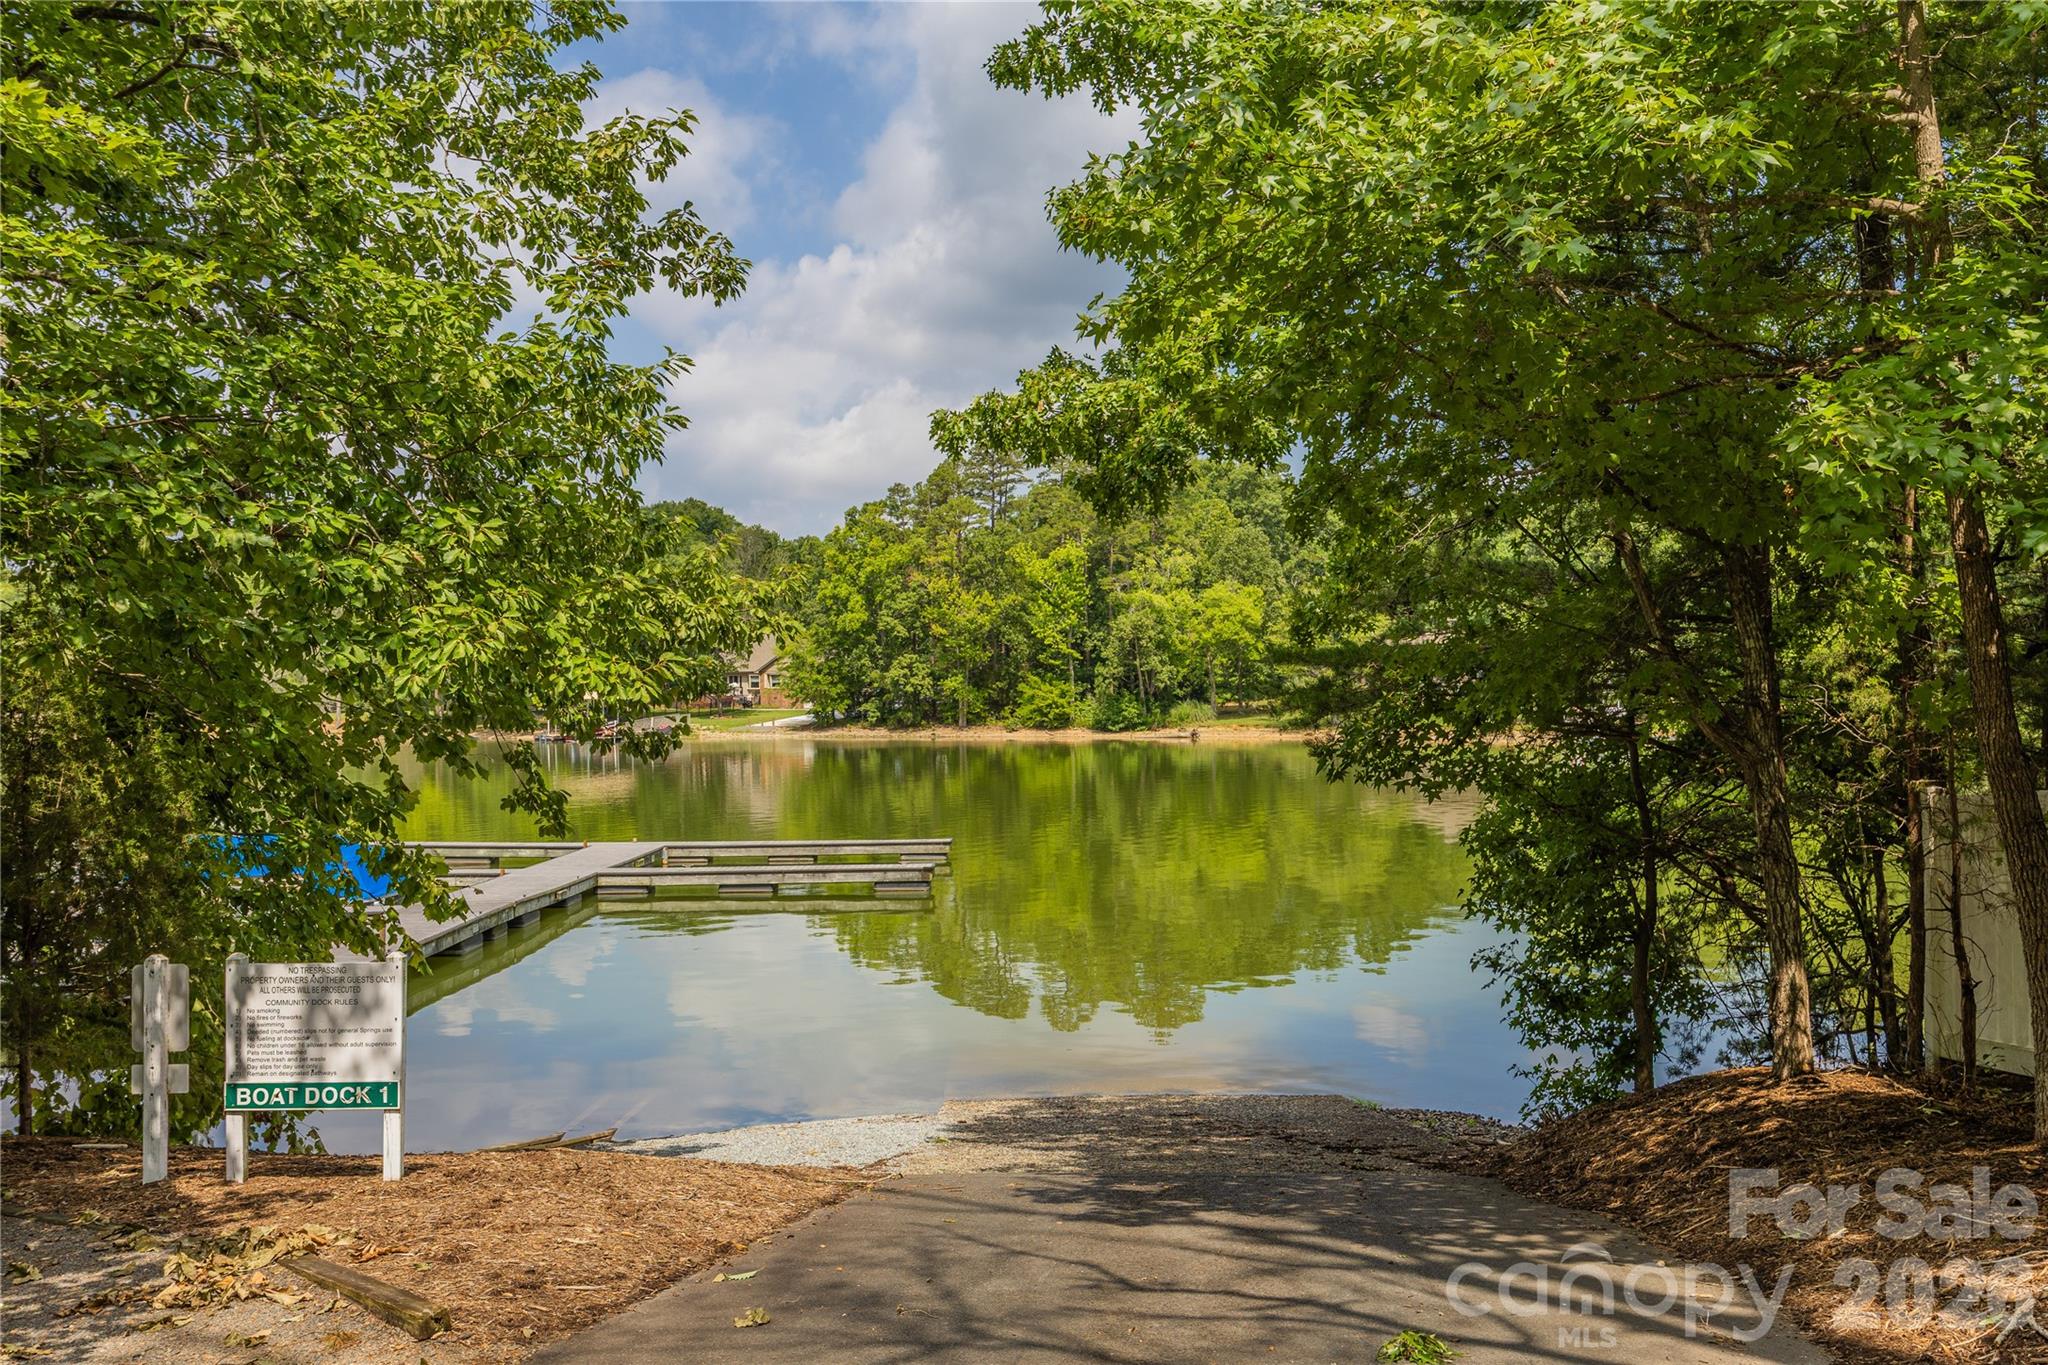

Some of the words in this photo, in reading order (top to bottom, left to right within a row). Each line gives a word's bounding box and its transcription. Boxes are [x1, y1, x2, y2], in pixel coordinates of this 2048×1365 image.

[288, 966, 299, 974] NO
[300, 966, 347, 974] TRESPASSING
[240, 976, 278, 984] PROPERTY
[279, 976, 308, 984] OWNERS
[310, 976, 324, 984] AND
[326, 976, 345, 984] THEIR
[347, 976, 375, 984] GUESTS
[260, 986, 270, 994] ALL
[271, 986, 296, 994] OTHERS
[297, 986, 310, 994] WILL
[312, 986, 320, 994] BE
[321, 986, 361, 994] PROSECUTED
[236, 1087, 298, 1106] BOAT
[305, 1086, 372, 1105] DOCK
[379, 1086, 389, 1105] 1
